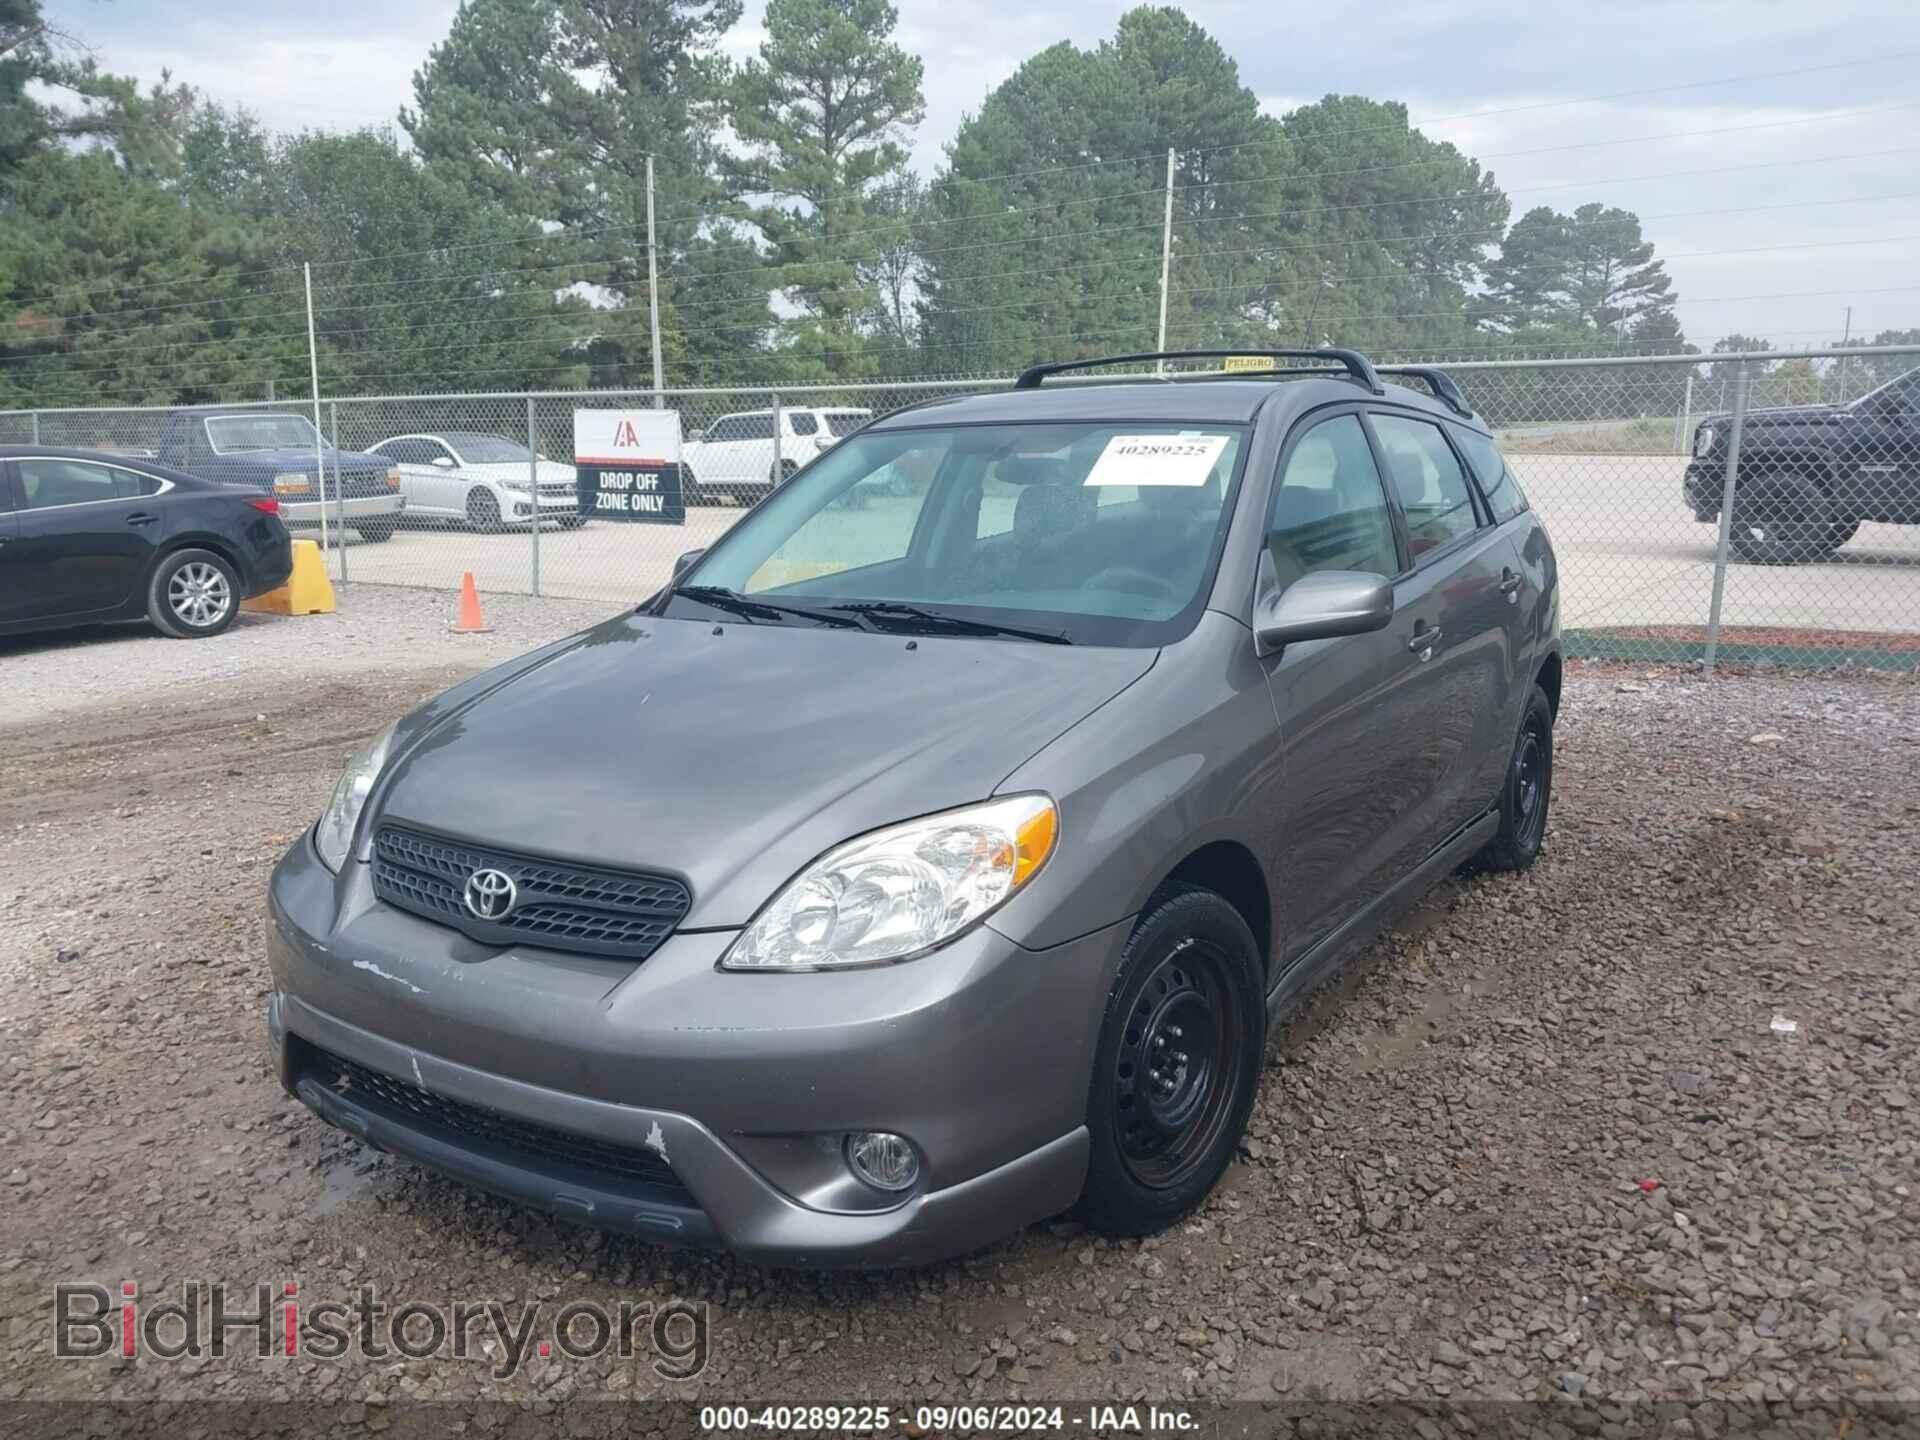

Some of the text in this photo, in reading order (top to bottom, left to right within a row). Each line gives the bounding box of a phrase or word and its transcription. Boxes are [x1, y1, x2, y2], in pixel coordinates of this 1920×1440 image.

[1115, 445, 1208, 456] 40289225
[600, 471, 659, 490] DROP OFF
[595, 492, 664, 512] ZONE ONLY
